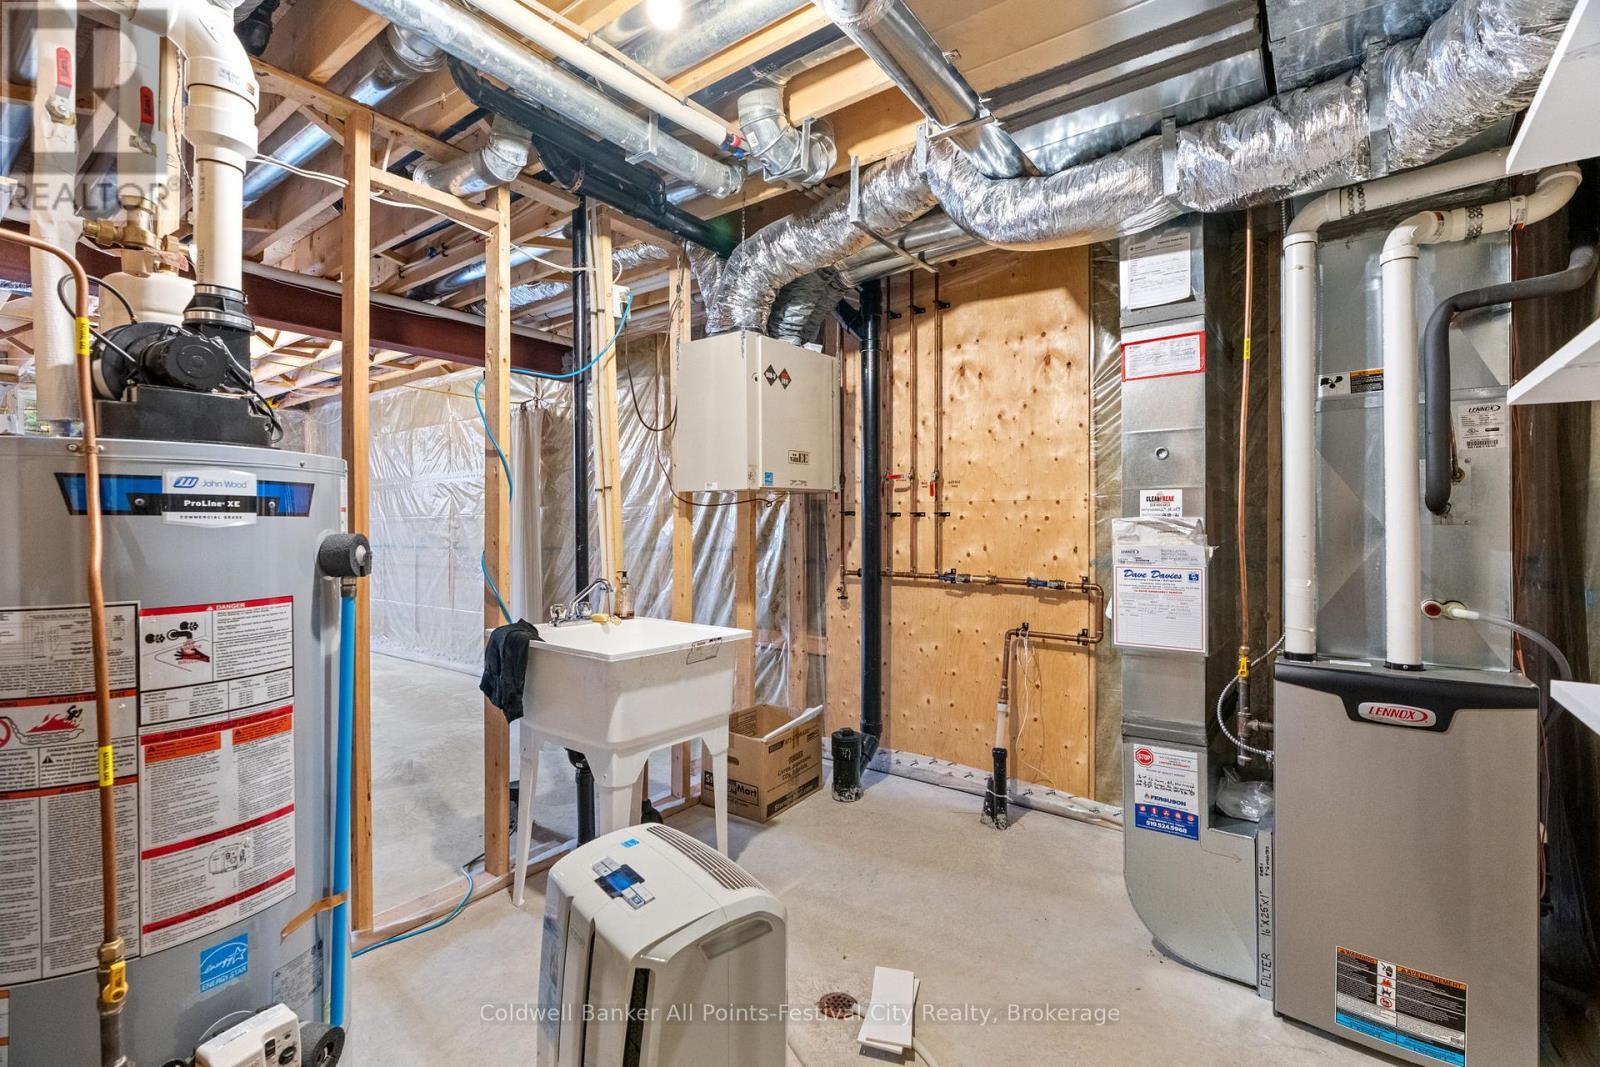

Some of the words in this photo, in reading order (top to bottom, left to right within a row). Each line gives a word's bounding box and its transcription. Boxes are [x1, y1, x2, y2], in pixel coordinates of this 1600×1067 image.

[226, 500, 241, 508] XE
[1123, 569, 1147, 578] Dave
[1150, 569, 1183, 580] Davies
[215, 602, 246, 610] DANGER
[1368, 705, 1416, 720] LENNOX
[1137, 753, 1152, 761] STOP
[1260, 952, 1272, 988] FILTER
